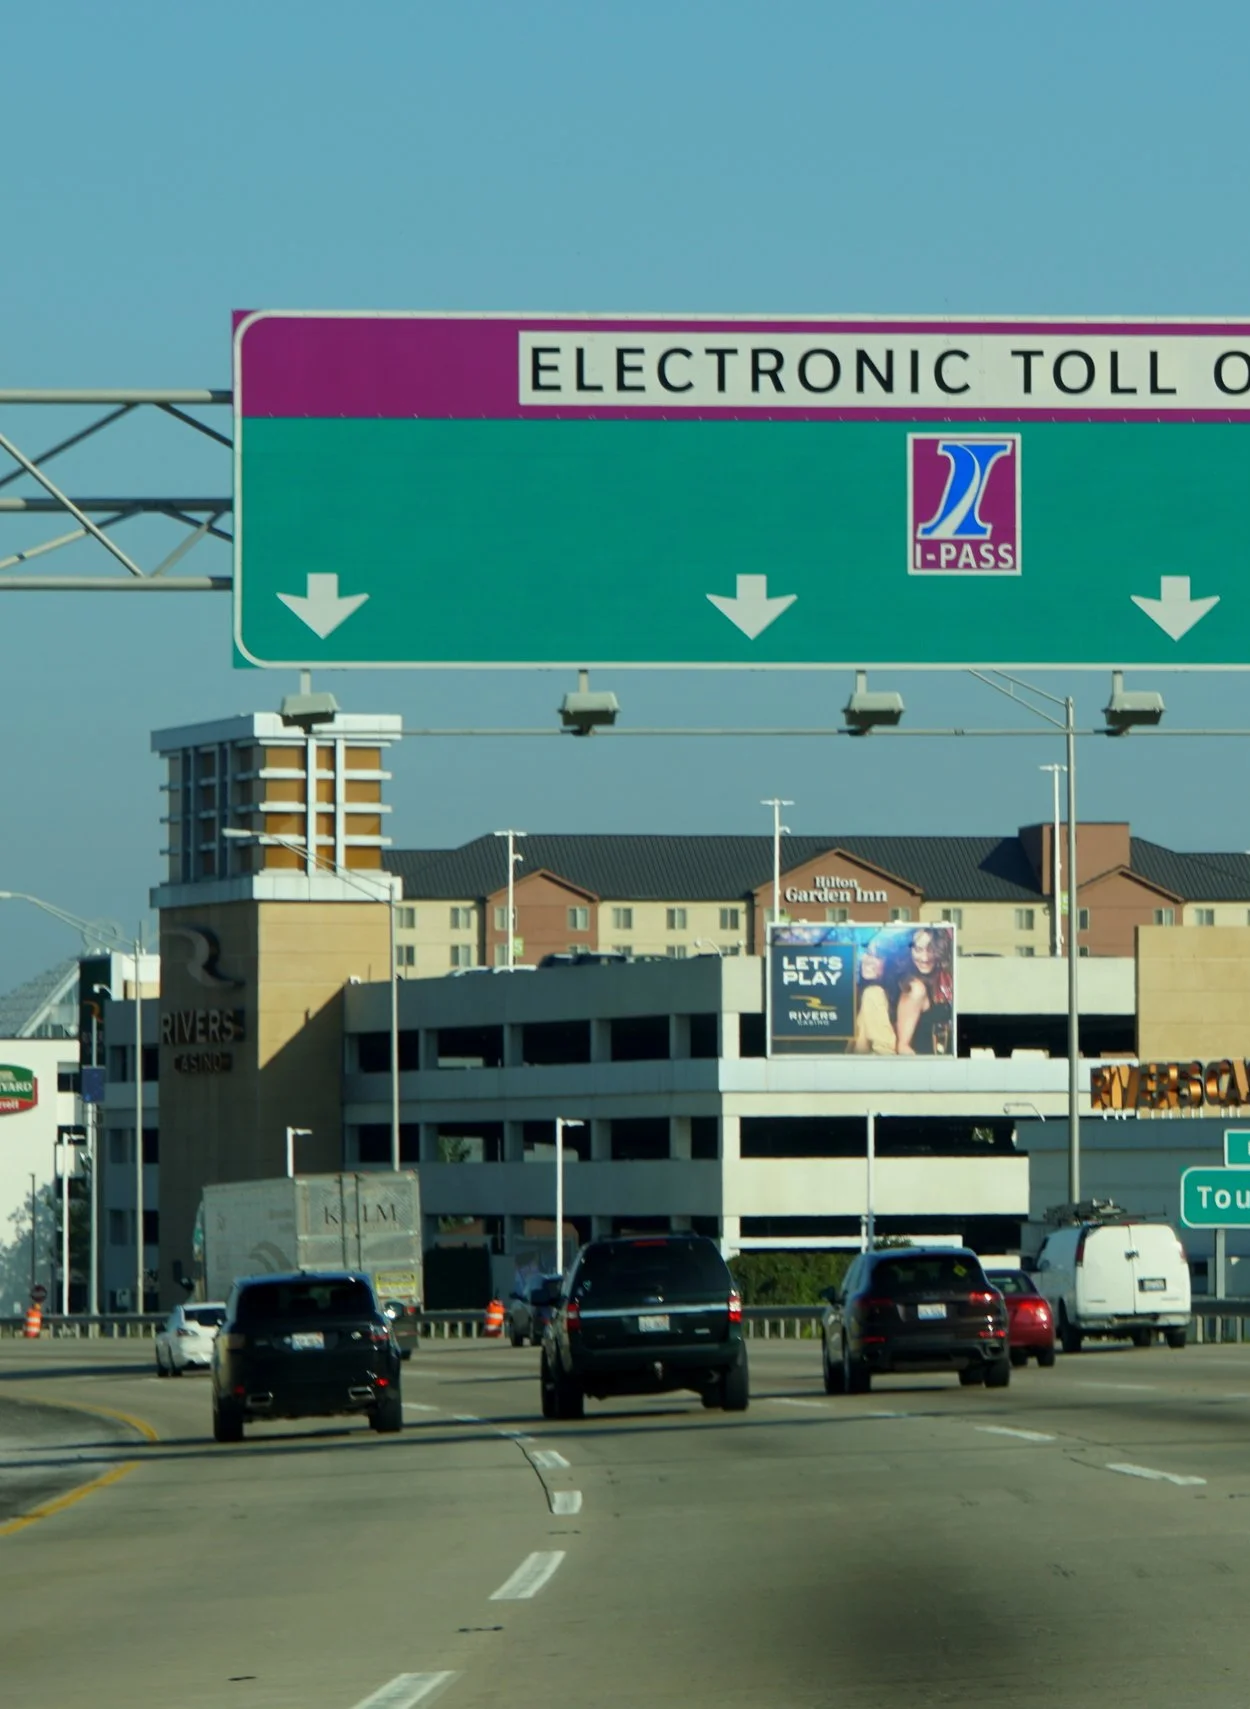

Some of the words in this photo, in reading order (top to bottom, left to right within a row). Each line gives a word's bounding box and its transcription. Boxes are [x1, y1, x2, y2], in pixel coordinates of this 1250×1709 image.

[531, 346, 971, 394] ELECTRONIC
[1010, 349, 1177, 396] TOLL
[915, 542, 1014, 570] I-PASS
[815, 876, 858, 888] Hilton
[785, 886, 851, 903] Garden
[855, 886, 888, 903] Inn
[783, 956, 843, 970] LET'S
[783, 971, 843, 986] PLAY
[788, 1010, 838, 1021] RIVERS
[161, 1009, 238, 1045] RIVERS
